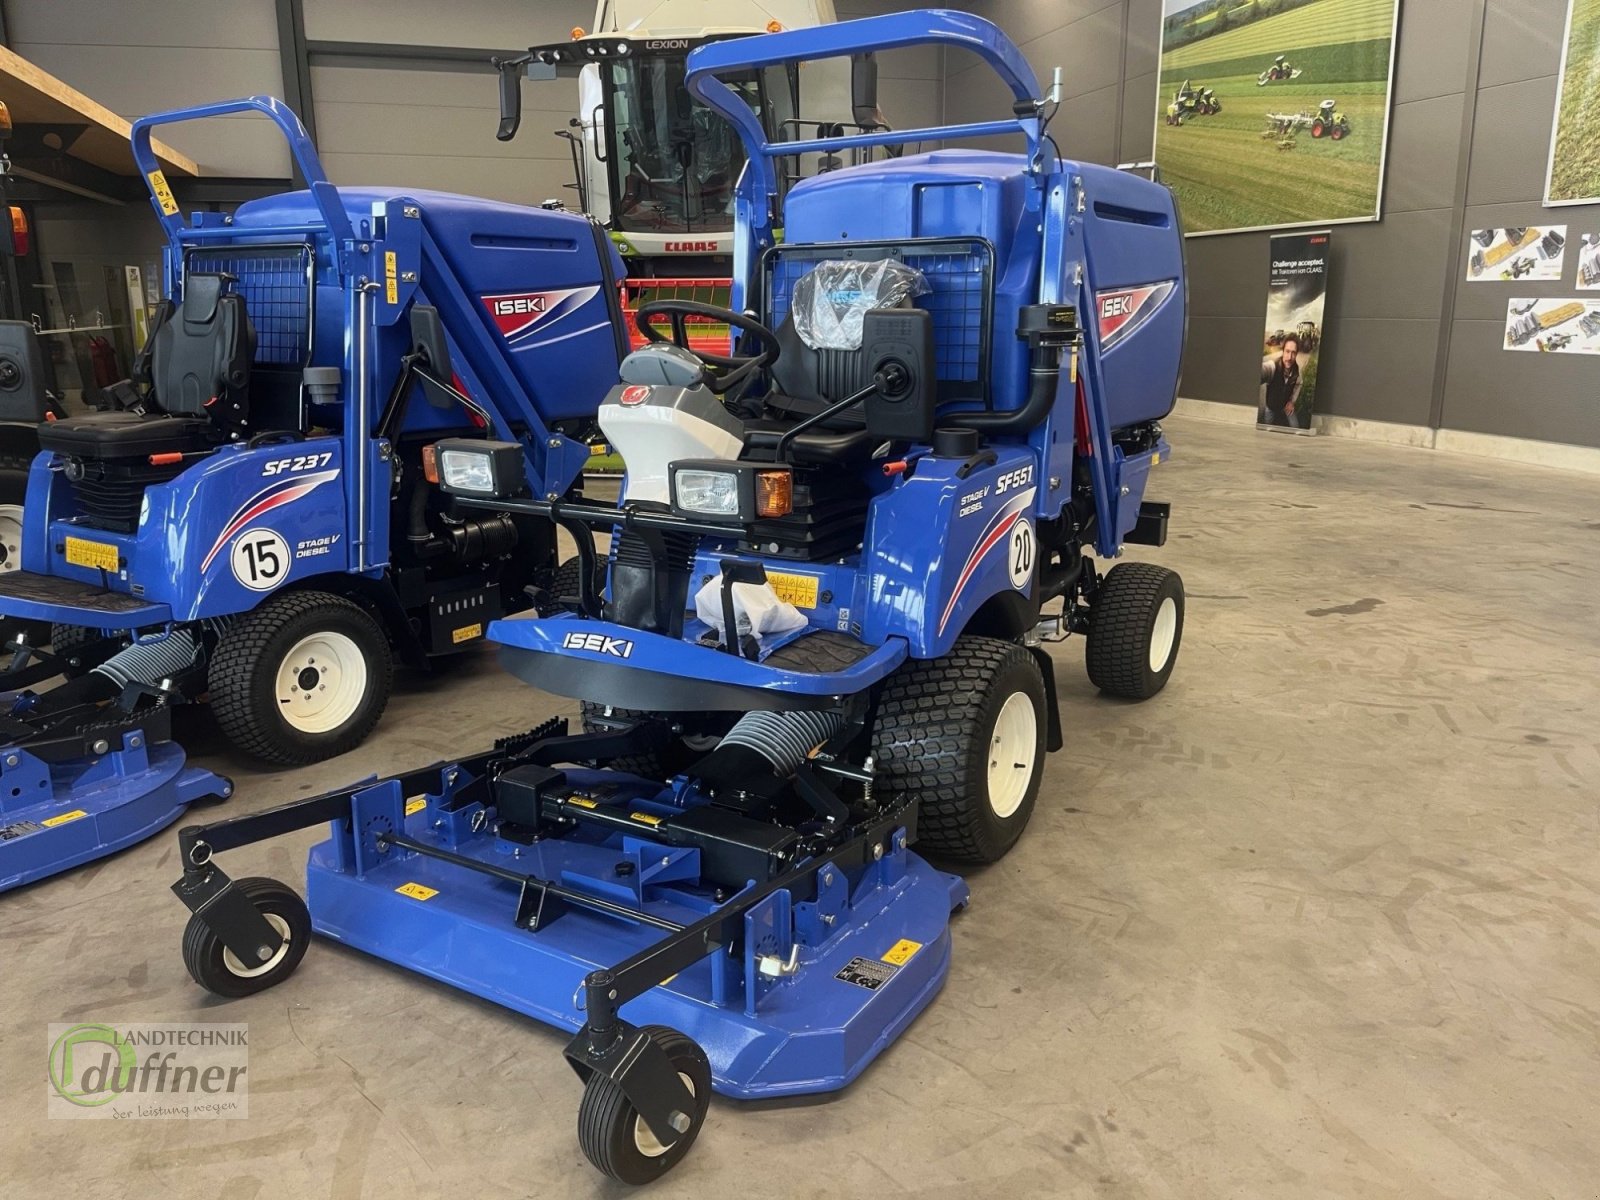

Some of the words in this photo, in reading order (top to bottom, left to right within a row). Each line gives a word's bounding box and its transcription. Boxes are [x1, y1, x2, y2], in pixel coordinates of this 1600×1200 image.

[645, 40, 689, 50] LEXION
[664, 241, 718, 252] CLAAS
[1272, 260, 1298, 269] Challenge
[1298, 258, 1324, 267] accepted.
[494, 297, 546, 316] ISEKI
[1101, 295, 1133, 319] ISEKI
[261, 452, 333, 477] SF237
[995, 464, 1034, 496] SF551
[960, 489, 985, 506] STAGE
[983, 485, 991, 497] V
[959, 501, 984, 518] DIESEL
[297, 536, 331, 549] STAGE
[331, 533, 341, 544] V
[242, 538, 280, 581] 15
[295, 546, 330, 559] DIESEL
[1014, 528, 1031, 575] 20
[562, 632, 634, 659] ISEKI
